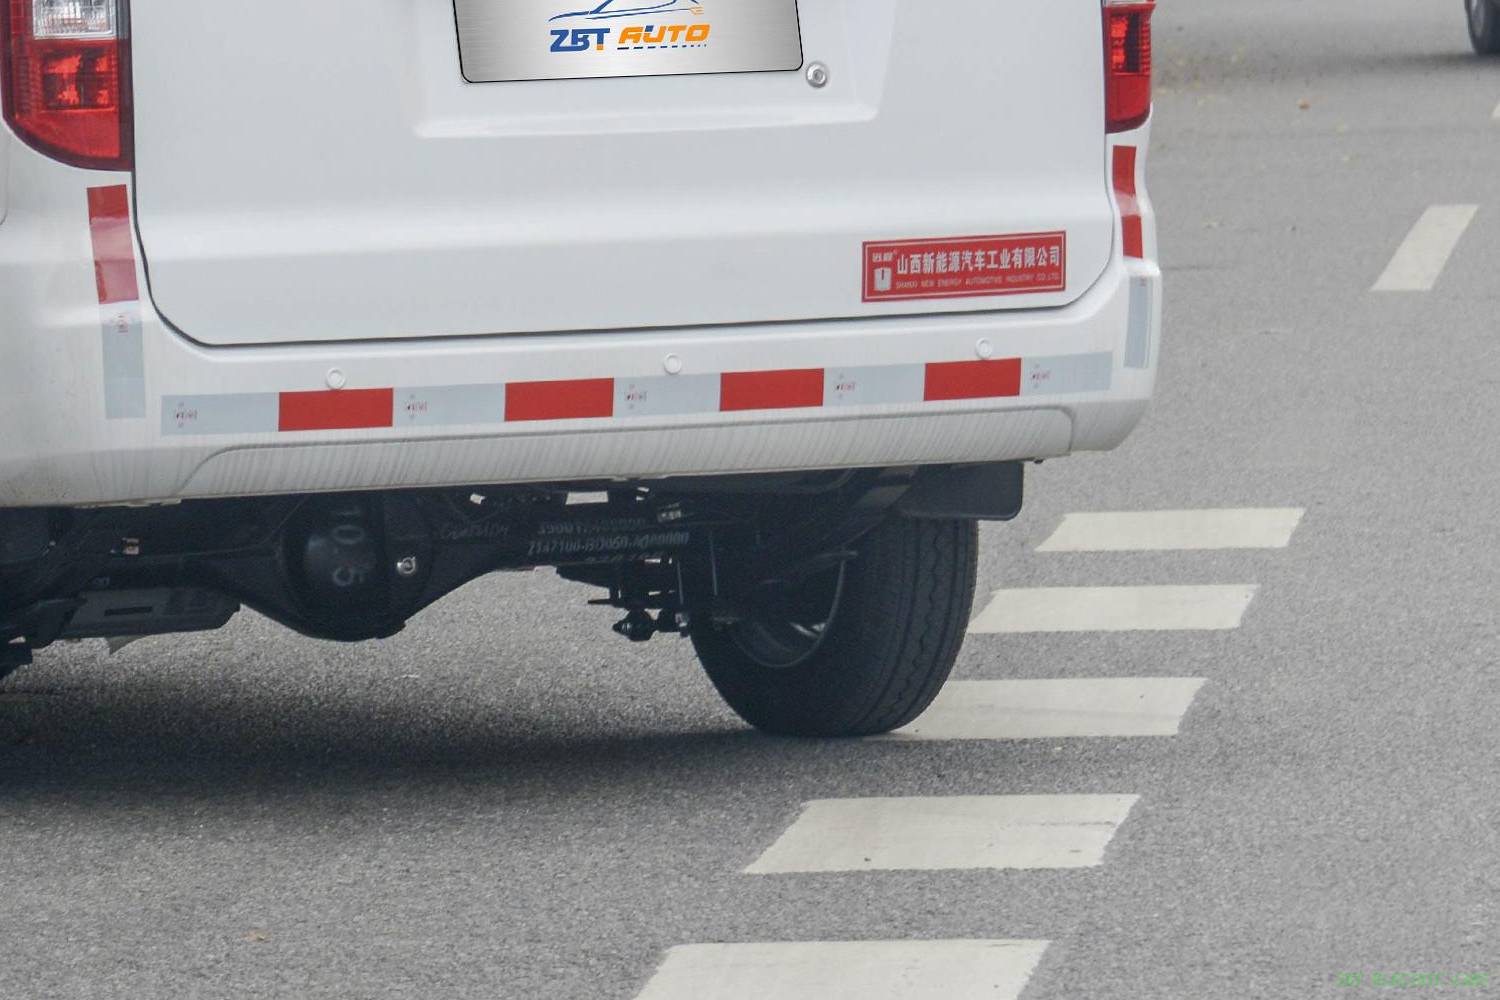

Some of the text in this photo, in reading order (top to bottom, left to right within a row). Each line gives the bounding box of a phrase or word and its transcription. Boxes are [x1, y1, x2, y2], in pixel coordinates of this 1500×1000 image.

[897, 245, 1060, 275] 山西新能源汽车工业有限公司
